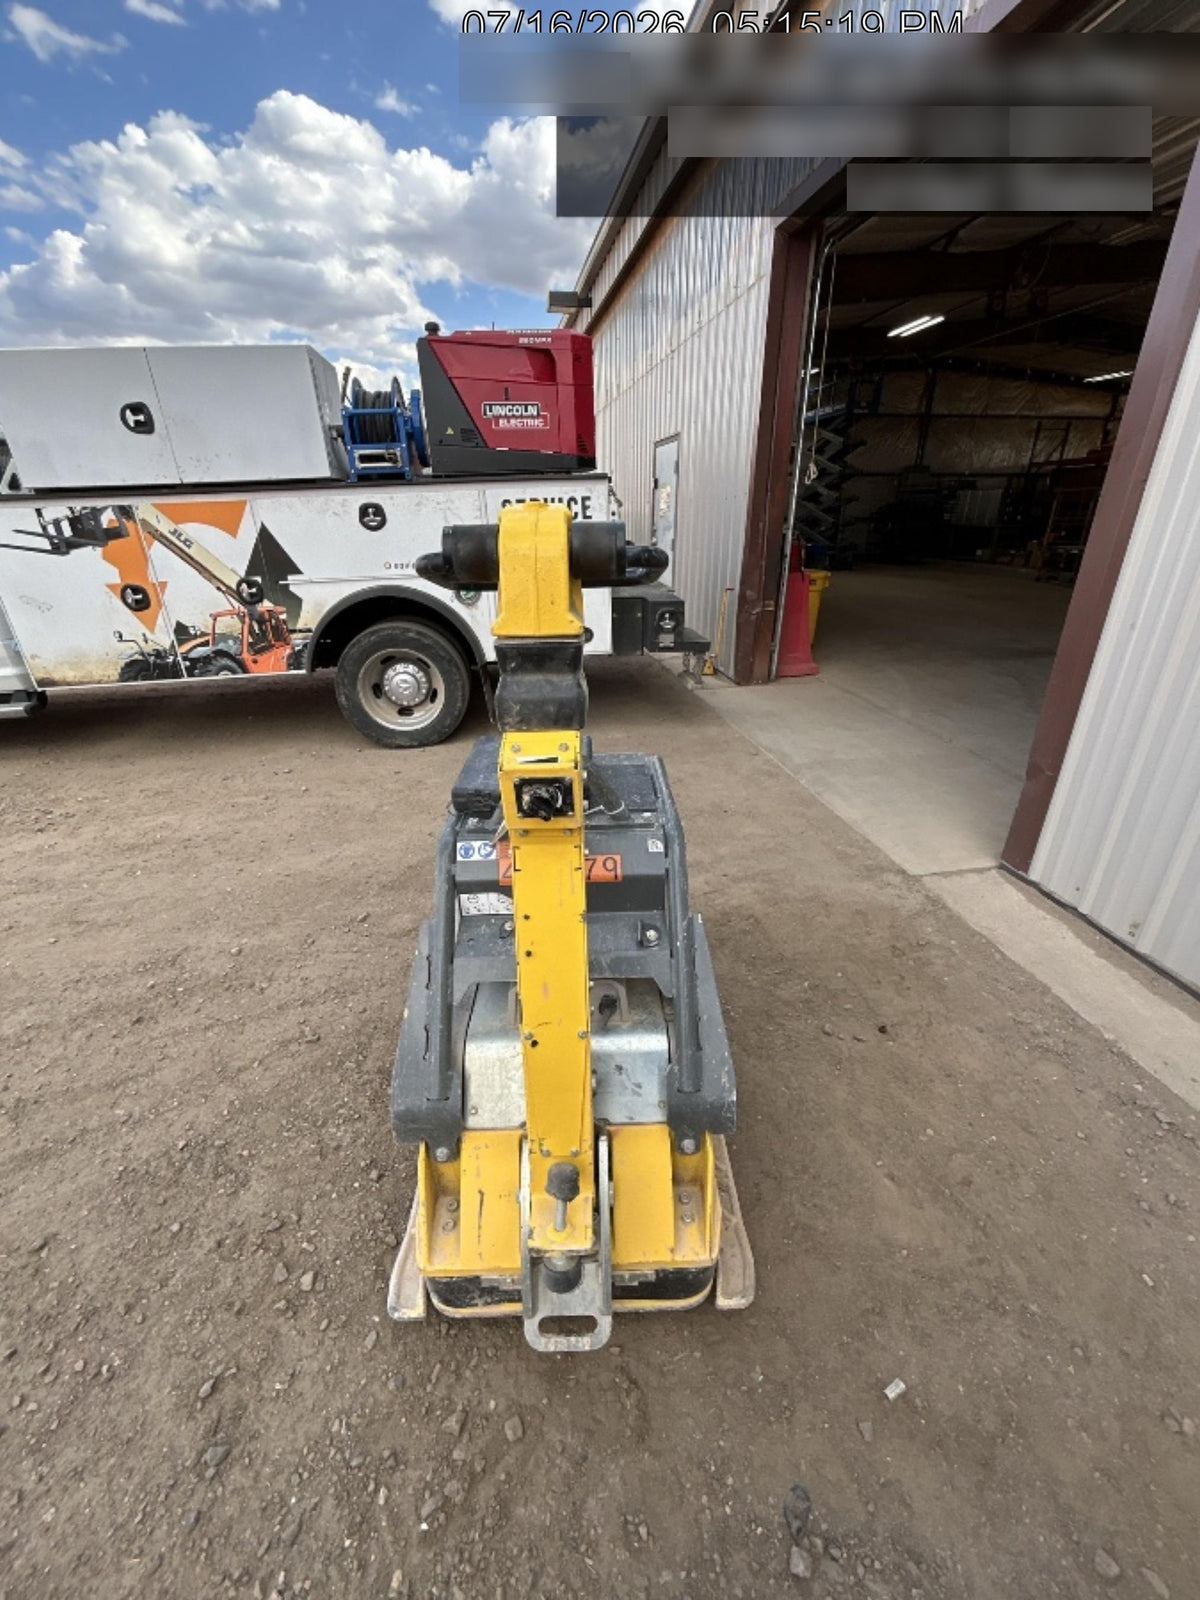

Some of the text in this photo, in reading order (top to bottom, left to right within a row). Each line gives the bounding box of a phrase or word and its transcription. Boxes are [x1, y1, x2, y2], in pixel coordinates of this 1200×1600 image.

[485, 404, 538, 417] LINCOLN
[499, 418, 545, 428] ELECTRIC
[168, 527, 194, 550] JLG
